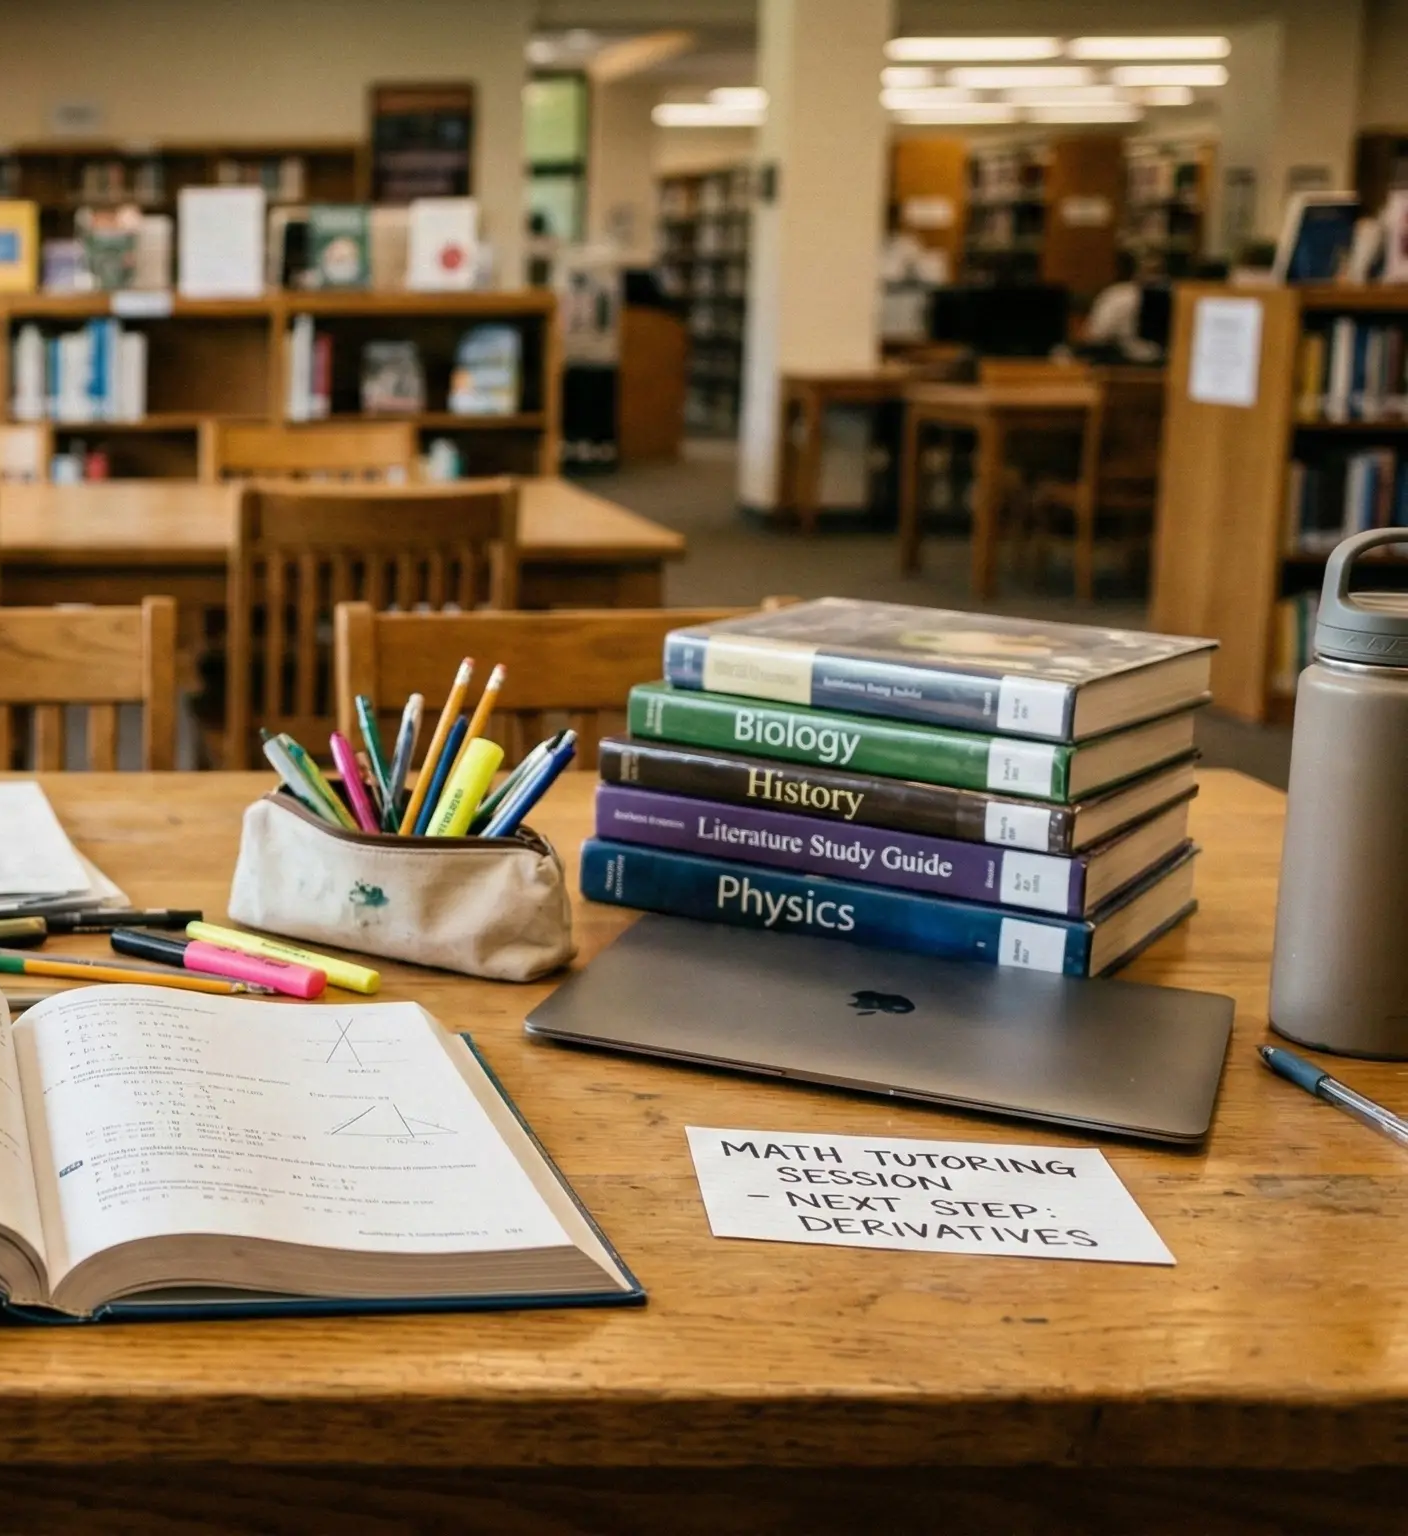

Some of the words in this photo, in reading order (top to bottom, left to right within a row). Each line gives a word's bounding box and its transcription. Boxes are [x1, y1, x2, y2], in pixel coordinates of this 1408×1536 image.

[734, 709, 861, 765] Biology
[746, 767, 864, 820] History
[697, 816, 803, 853] Literature
[809, 834, 875, 870] Study
[881, 846, 953, 877] Guide
[717, 875, 855, 931] Physics
[720, 1139, 843, 1164] MATH
[864, 1148, 1078, 1178] TUTORING
[776, 1166, 953, 1192] SESSION
[786, 1191, 901, 1213] NEXT
[930, 1199, 1057, 1220] STEP:
[797, 1214, 1099, 1247] DERIVATIVES
